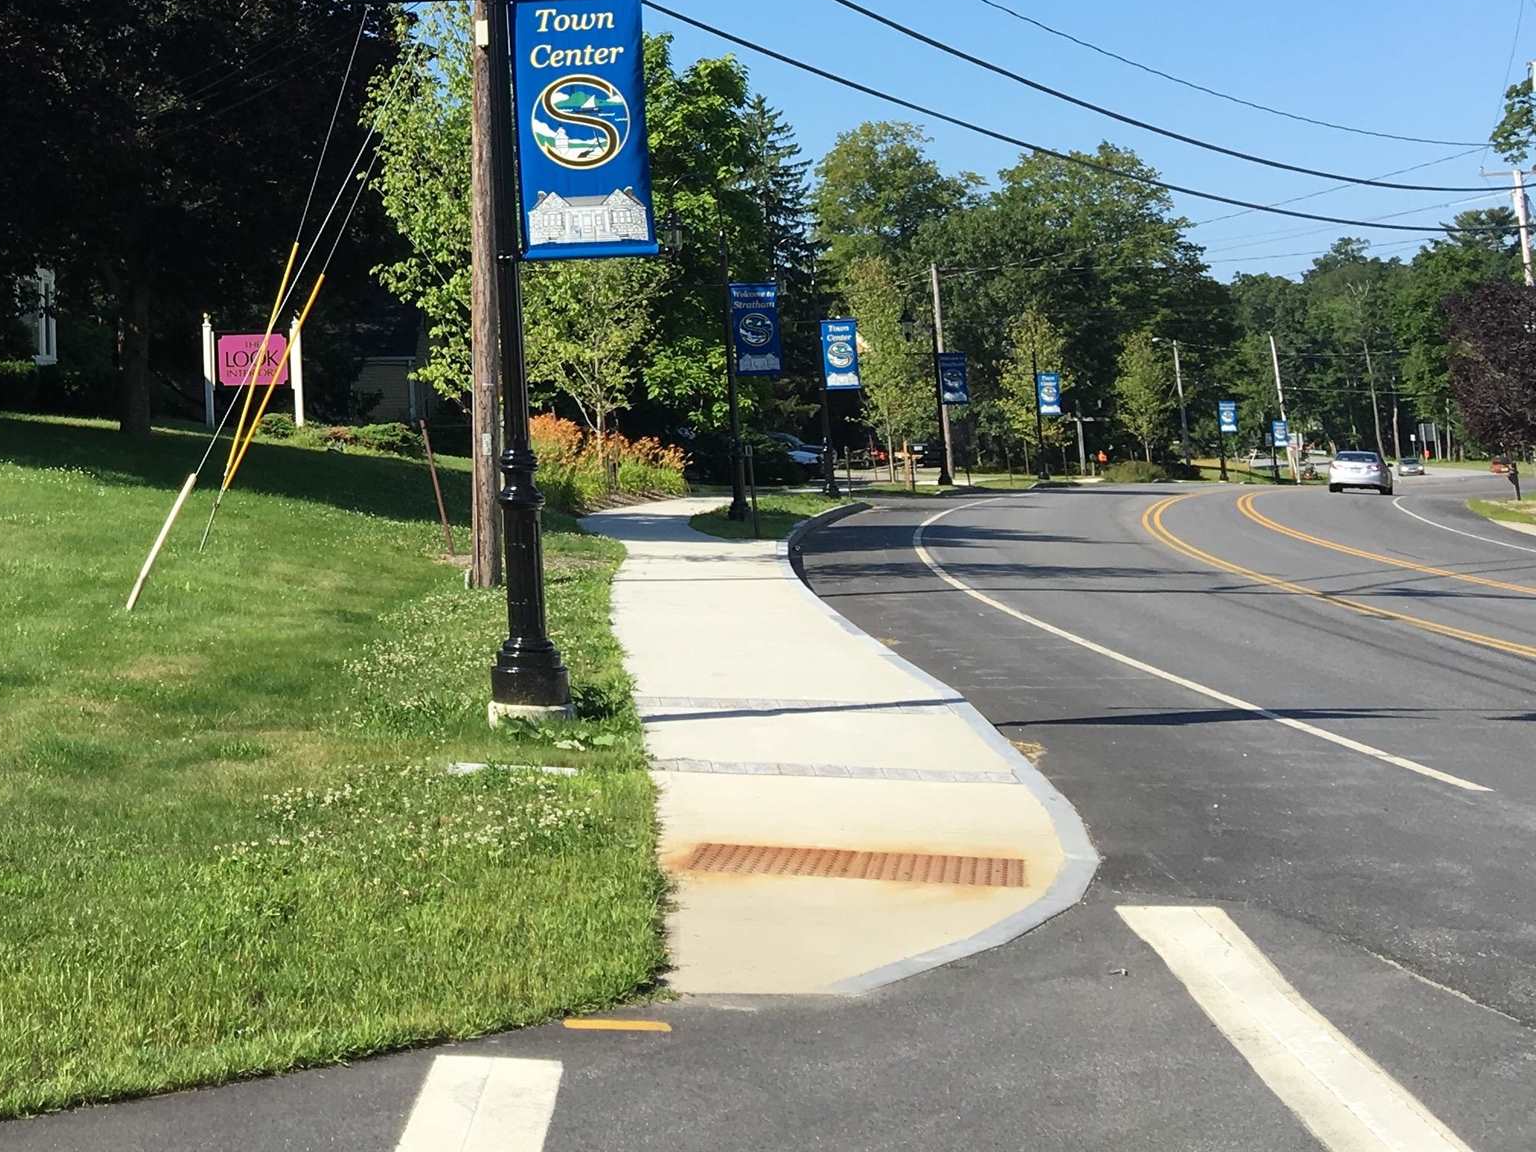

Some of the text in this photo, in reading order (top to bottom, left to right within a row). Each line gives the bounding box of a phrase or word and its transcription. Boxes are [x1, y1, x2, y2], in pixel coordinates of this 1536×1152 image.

[535, 8, 615, 32] Town
[530, 44, 624, 69] Center
[225, 350, 280, 368] LOOK
